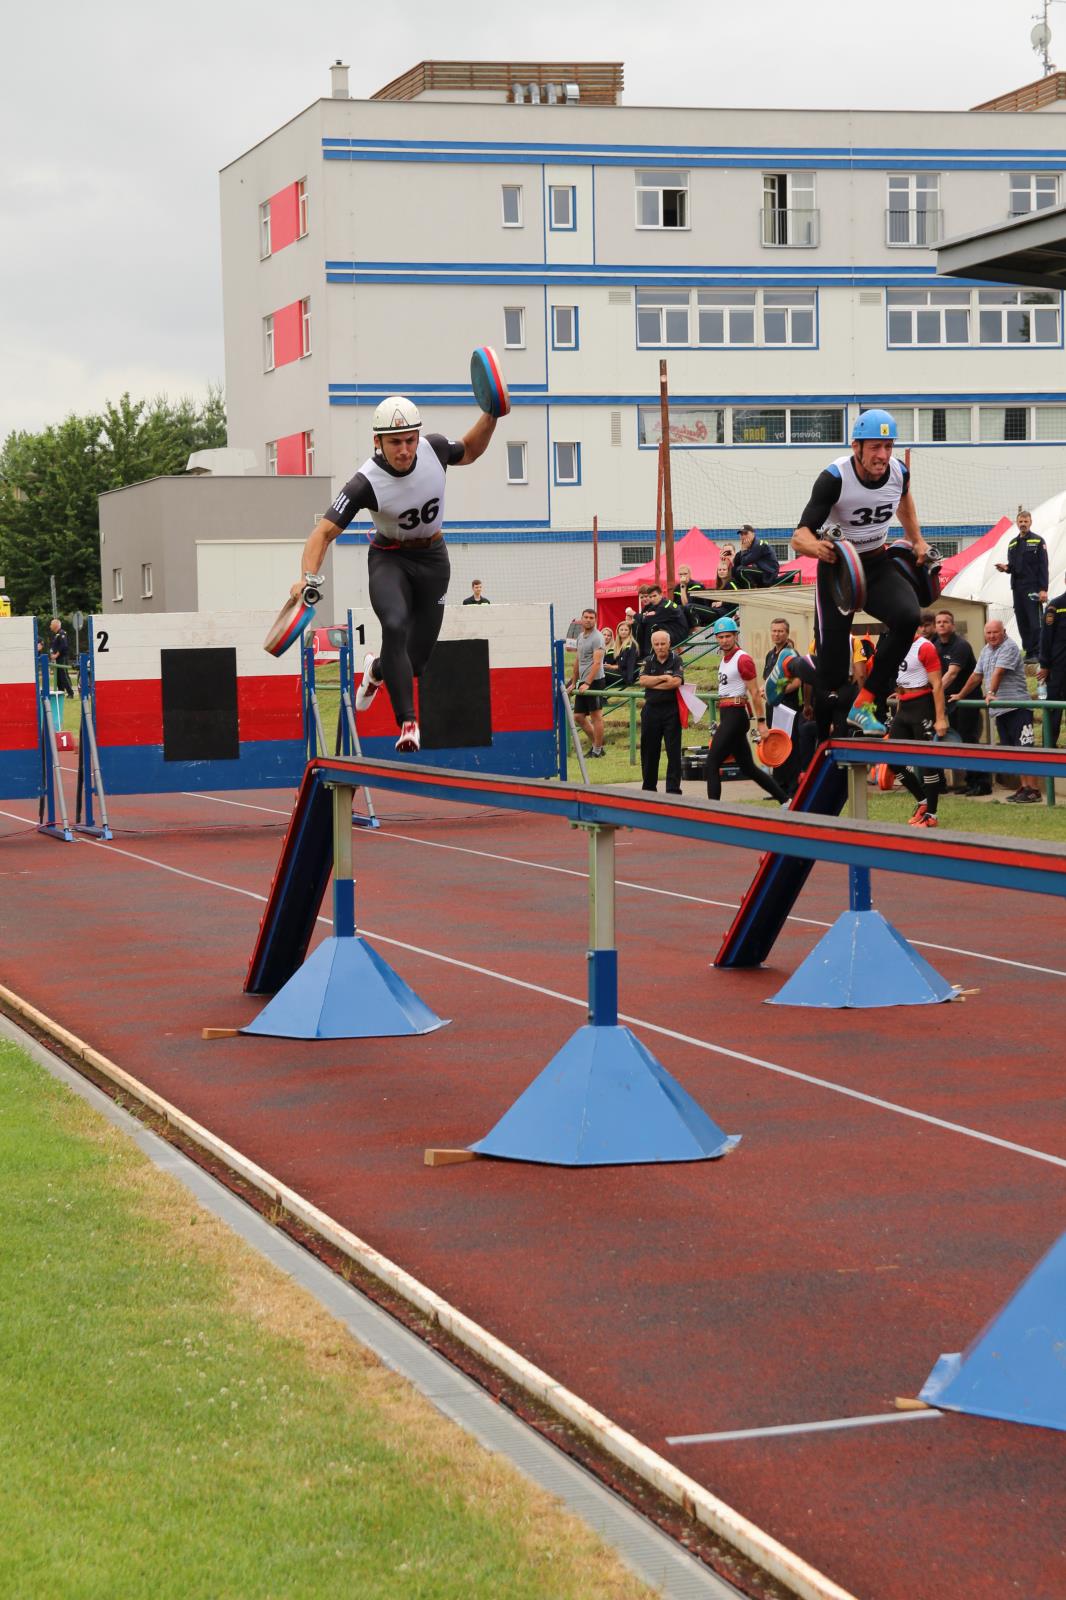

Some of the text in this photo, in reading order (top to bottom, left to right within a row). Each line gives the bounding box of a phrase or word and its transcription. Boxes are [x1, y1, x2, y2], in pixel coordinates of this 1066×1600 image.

[398, 498, 440, 530] 36
[850, 503, 893, 526] 35
[97, 631, 109, 652] 2
[355, 624, 365, 645] 1
[60, 735, 67, 747] 1
